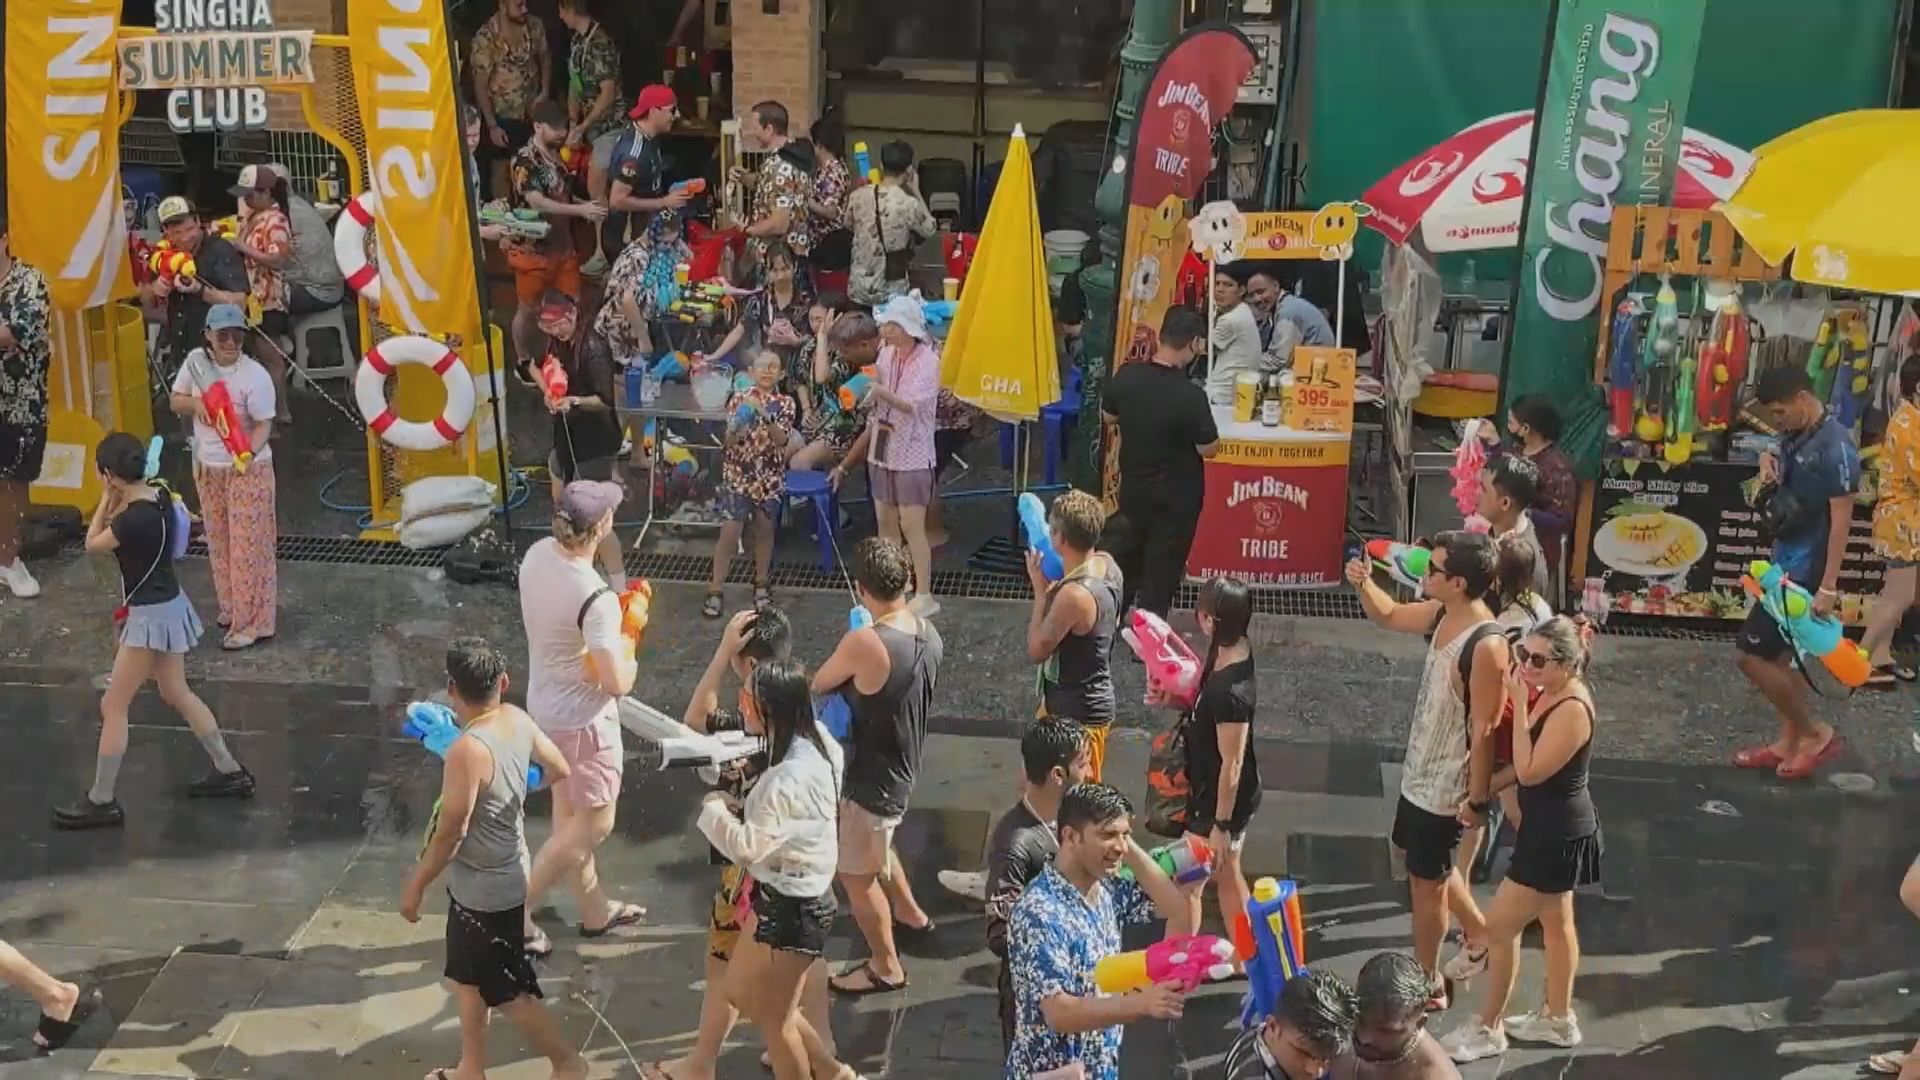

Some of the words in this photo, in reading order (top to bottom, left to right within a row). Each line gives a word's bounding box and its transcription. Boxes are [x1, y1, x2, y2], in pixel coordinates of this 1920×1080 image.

[155, 0, 273, 30] SINGHA
[122, 36, 304, 86] SUMMER
[44, 0, 114, 180] SIN
[167, 88, 268, 130] CLUB
[1155, 147, 1190, 178] TRIBE
[1535, 12, 1660, 321] Chang
[1637, 100, 1673, 207] INERAL
[1297, 388, 1329, 406] 395
[1244, 446, 1274, 458] ENJOY
[1279, 447, 1325, 459] TOGETHER
[1226, 480, 1261, 508] JIM
[1261, 475, 1309, 512] BEAM
[1240, 537, 1289, 560] TRIBE
